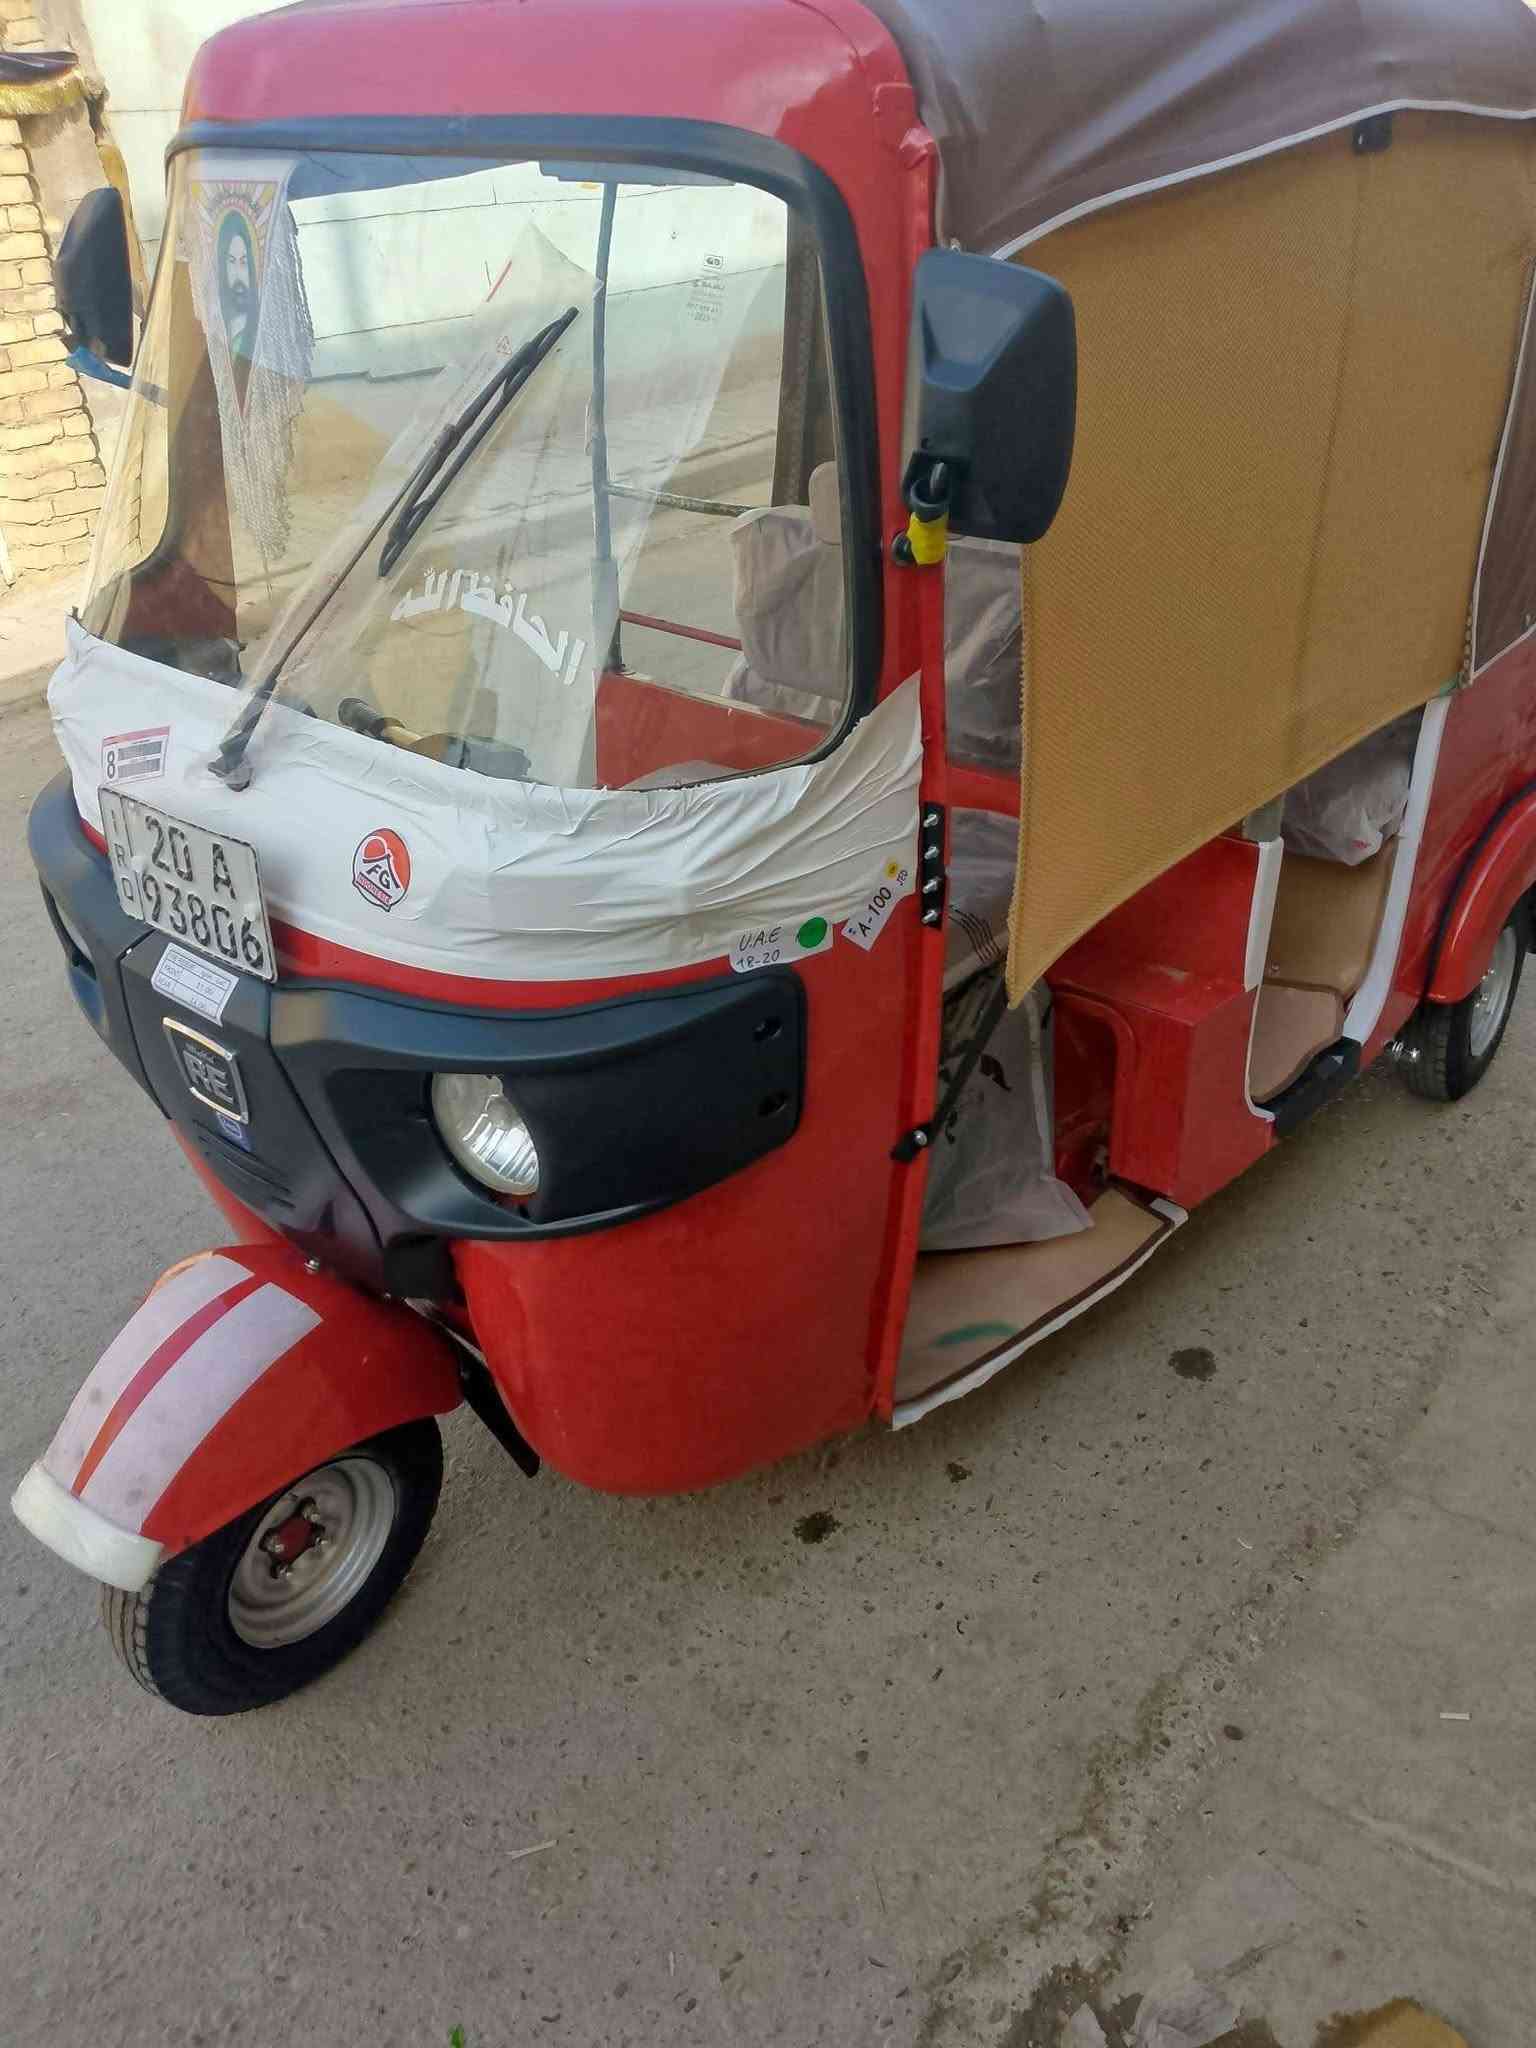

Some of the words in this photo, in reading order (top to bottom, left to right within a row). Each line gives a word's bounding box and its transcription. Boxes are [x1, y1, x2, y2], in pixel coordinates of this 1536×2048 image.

[145, 815, 193, 882] 20
[212, 843, 237, 900] A
[142, 873, 264, 969] 93806
[857, 887, 892, 938] A-100
